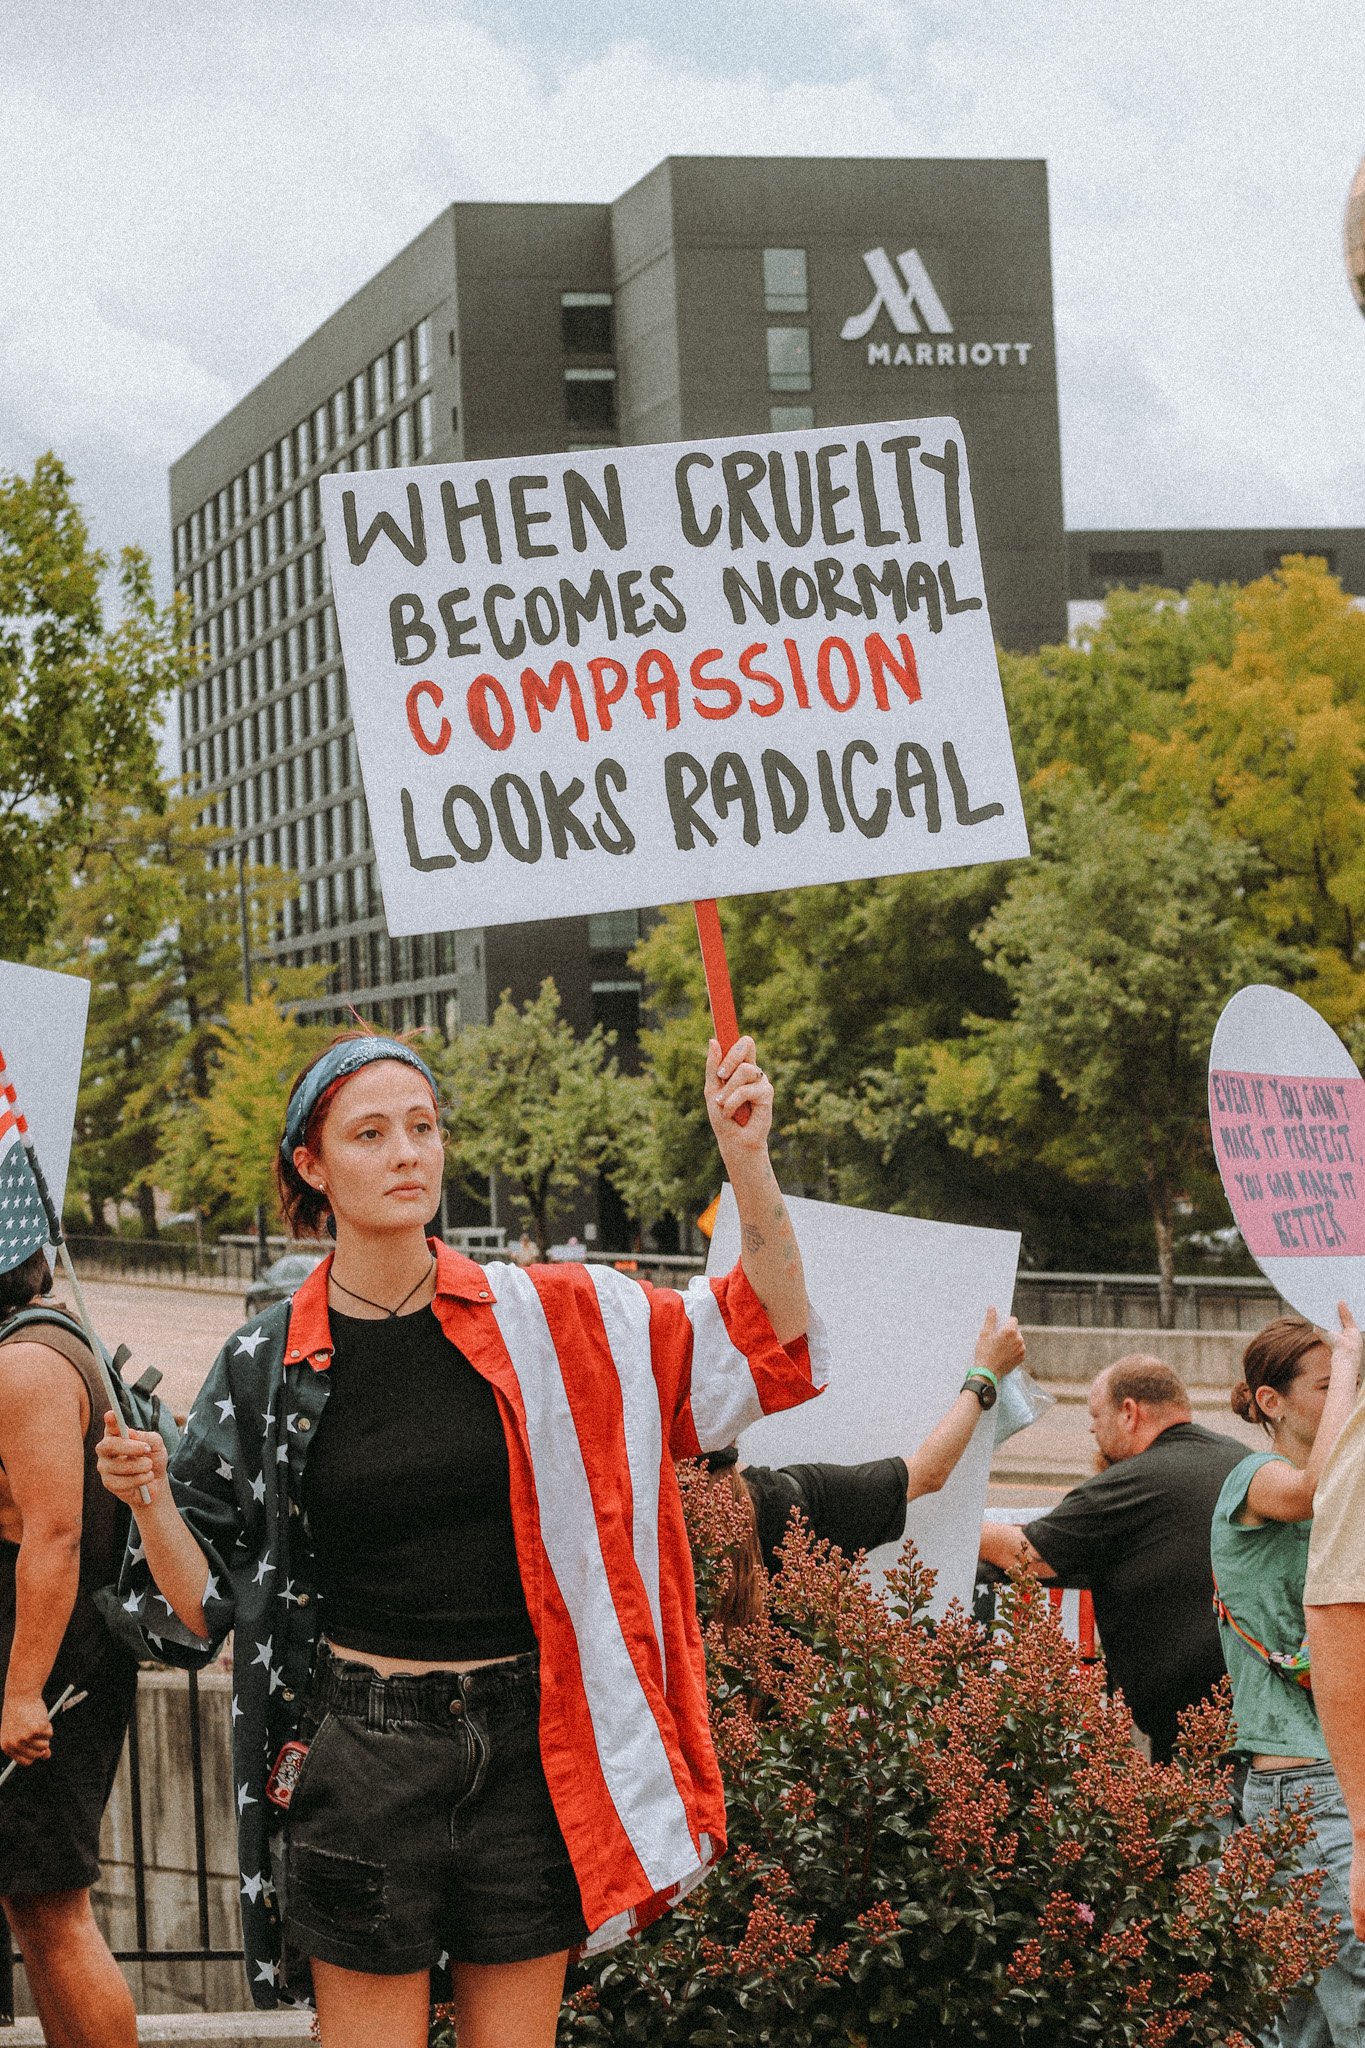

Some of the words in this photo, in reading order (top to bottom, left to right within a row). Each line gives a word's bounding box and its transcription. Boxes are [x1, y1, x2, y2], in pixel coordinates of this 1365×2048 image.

[867, 342, 1032, 366] MARRIOTT
[344, 464, 627, 566] WHEN
[675, 436, 964, 549] CRUELTY
[389, 565, 687, 667] BECOMES
[722, 558, 982, 633] NORMAL
[405, 632, 922, 756] COMPASSION
[400, 758, 635, 872] LOOKS
[664, 740, 1004, 851] RADICAL
[1213, 1074, 1252, 1115] EVEN
[1251, 1079, 1268, 1120] IF
[1269, 1079, 1303, 1121] YOU
[1302, 1084, 1350, 1121] CAN'T
[1220, 1123, 1260, 1160] MAKE
[1262, 1126, 1279, 1159] IT
[1234, 1172, 1263, 1201] YOU
[1266, 1170, 1297, 1200] CAN
[1297, 1169, 1339, 1201] MAKE
[1338, 1171, 1356, 1200] IT
[1272, 1200, 1347, 1248] BETTER
